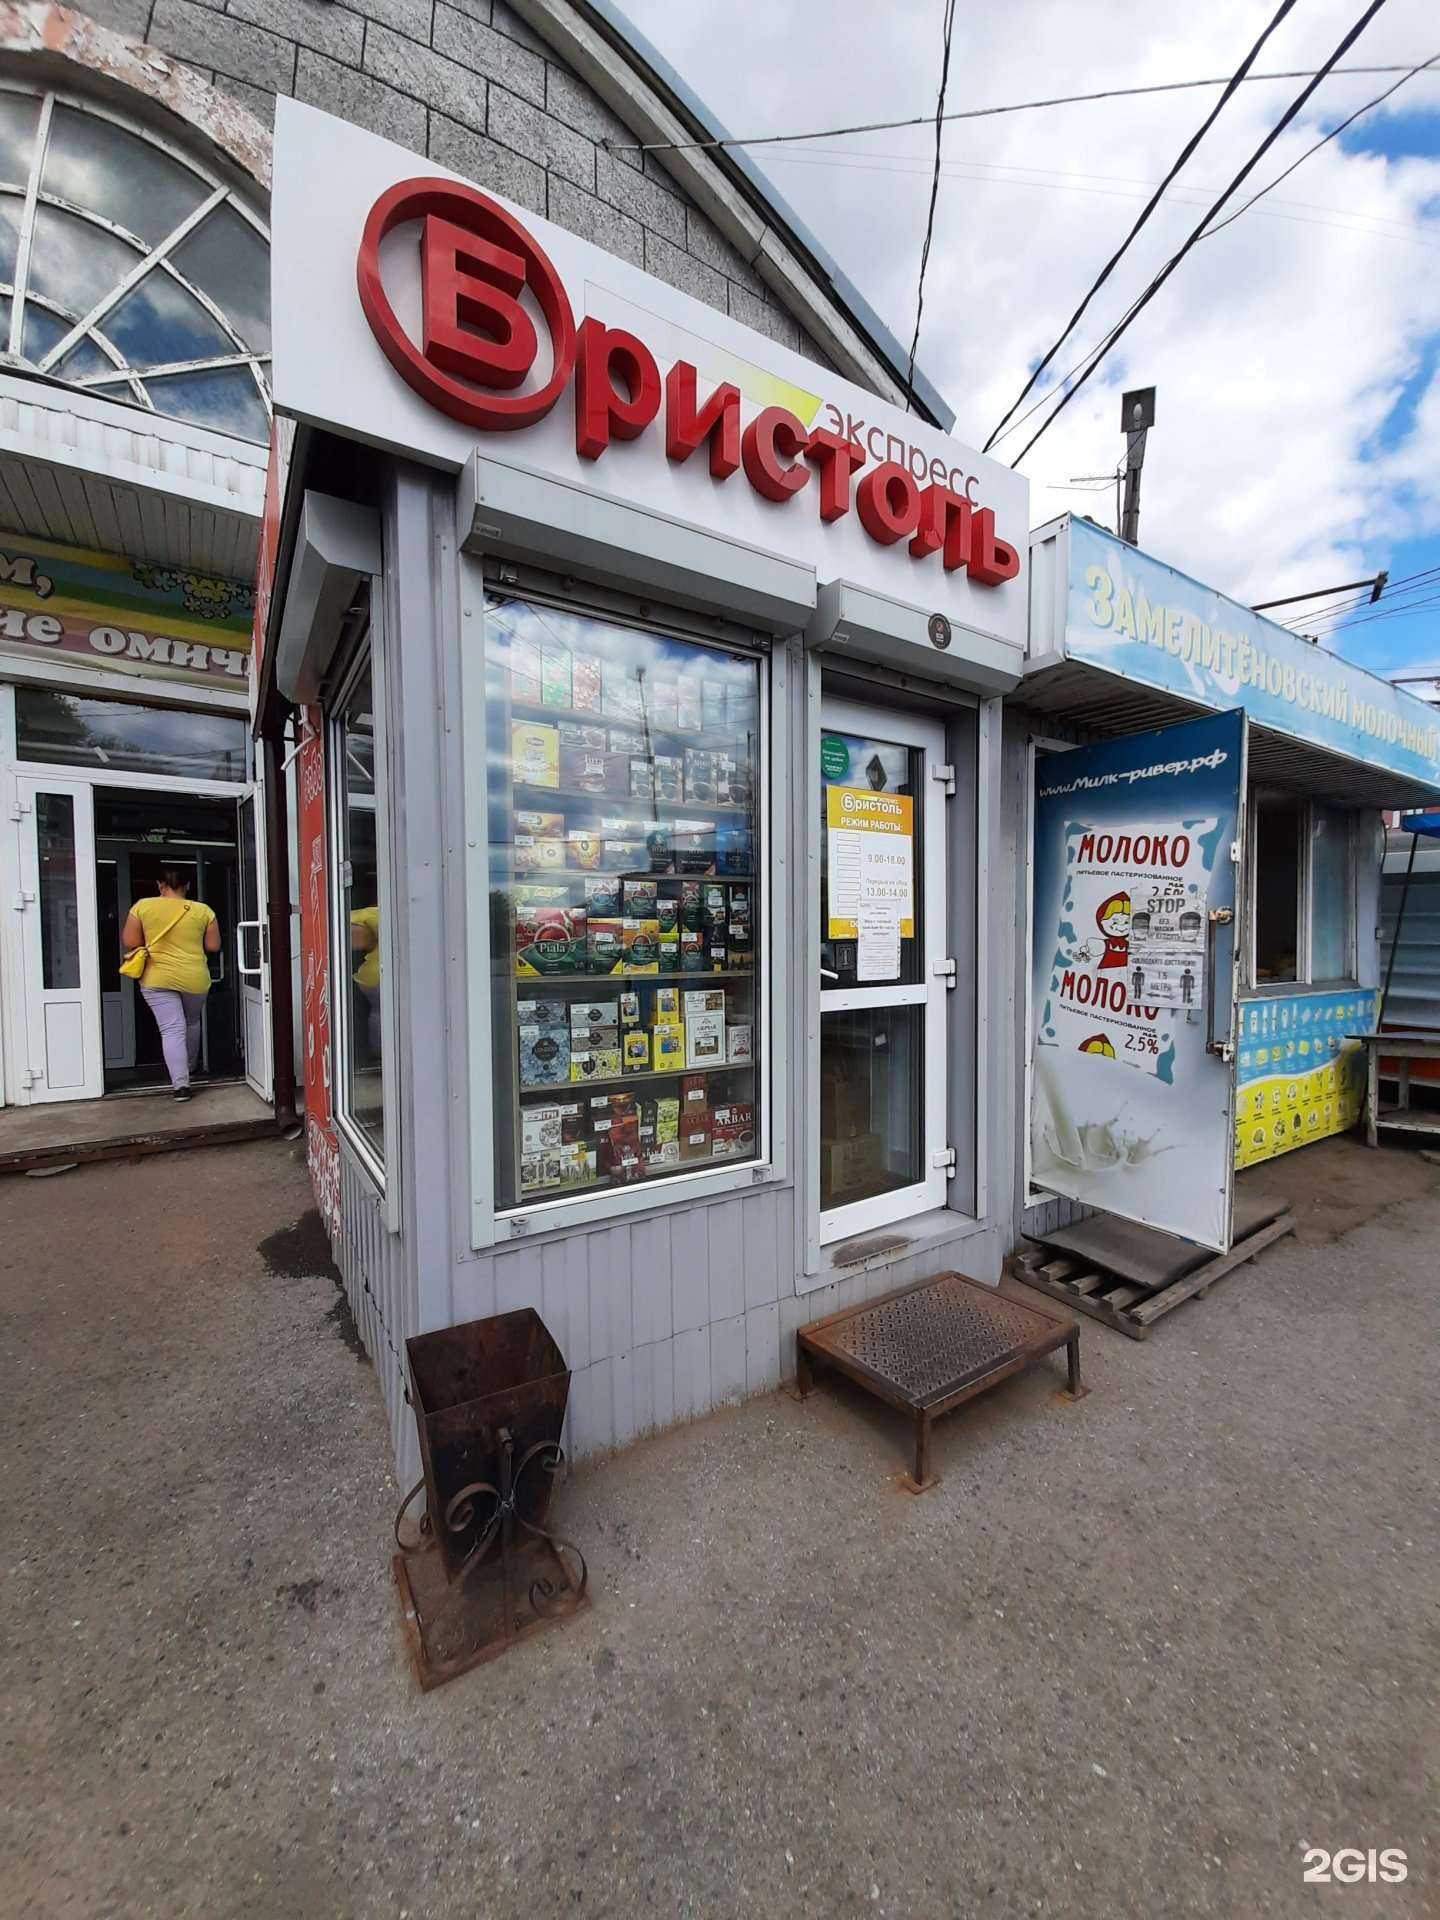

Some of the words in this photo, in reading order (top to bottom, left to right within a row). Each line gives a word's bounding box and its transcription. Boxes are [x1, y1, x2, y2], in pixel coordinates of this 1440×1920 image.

[357, 176, 1021, 588] Бристоль
[89, 627, 250, 676] омич
[841, 792, 903, 815] Бристоль
[840, 816, 869, 828] РЕЖИМ
[870, 819, 904, 832] РАБОТЫ:
[1076, 834, 1191, 868] МОЛОКО
[1110, 871, 1184, 882] ПАСТЕРИЗОВАННОЕ
[1147, 898, 1186, 914] STOP
[539, 943, 566, 953] Piala
[1089, 1011, 1157, 1033] ПАСТЕРИЗОВАННОЕ
[1124, 1033, 1159, 1055] 2,5%
[717, 1111, 752, 1127] AKBAR
